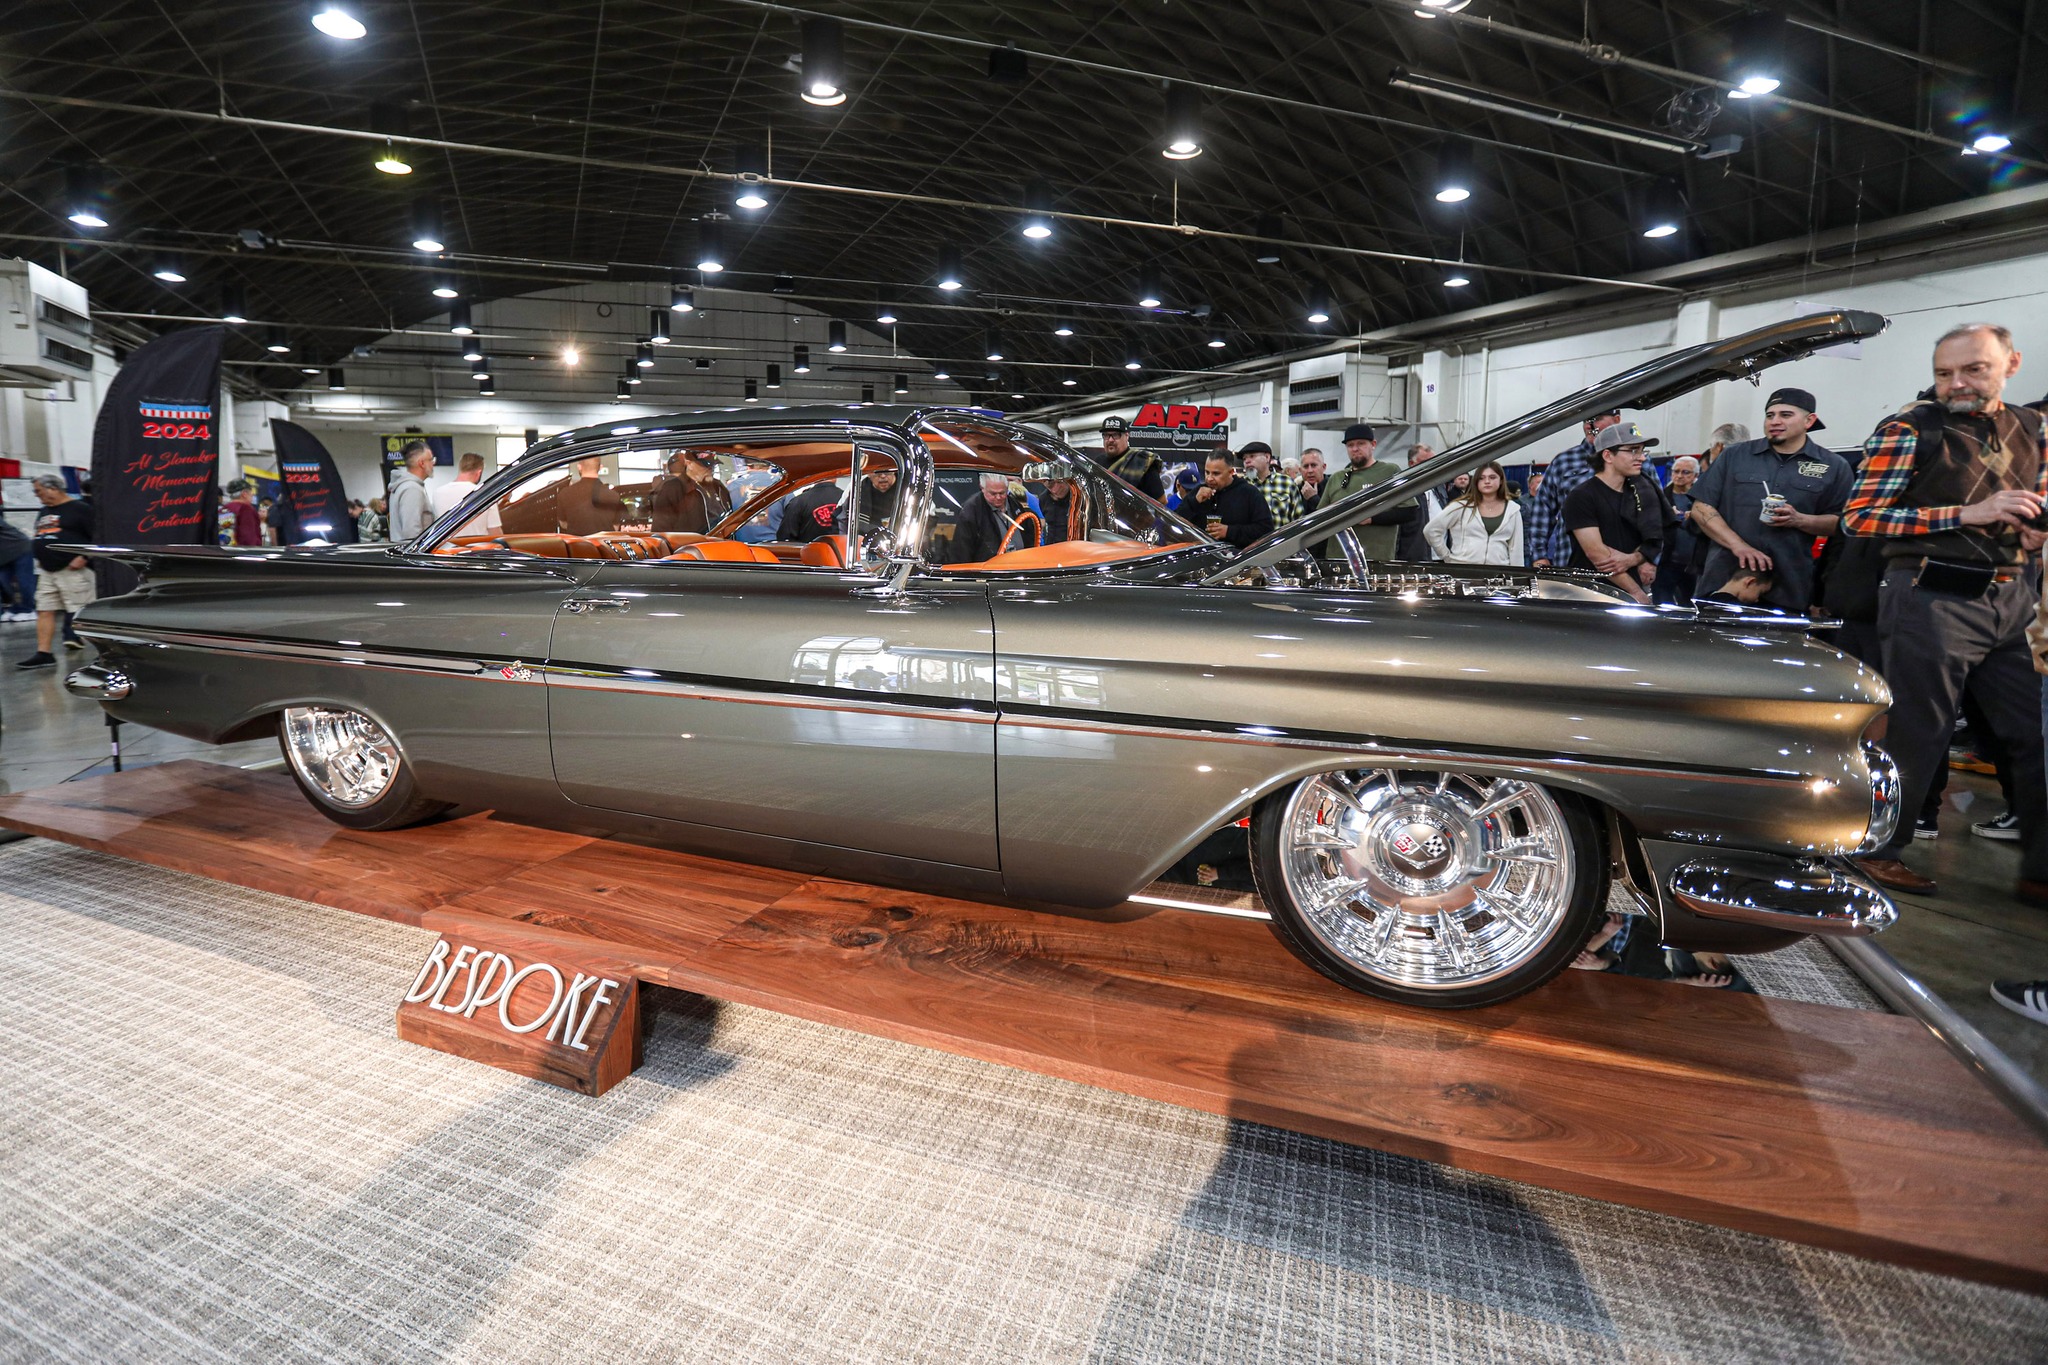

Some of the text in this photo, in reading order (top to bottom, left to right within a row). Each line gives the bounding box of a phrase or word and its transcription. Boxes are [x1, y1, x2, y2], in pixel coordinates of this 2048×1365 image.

[1426, 384, 1435, 393] 18
[1132, 403, 1228, 429] ARP
[1262, 406, 1270, 414] 20
[142, 421, 212, 440] 2024
[1193, 431, 1227, 442] products
[122, 449, 217, 473] Al Slonaker
[132, 469, 212, 491] Memorial
[285, 473, 320, 483] 2024
[146, 490, 203, 512] Award
[404, 940, 619, 1052] BESPOKE
